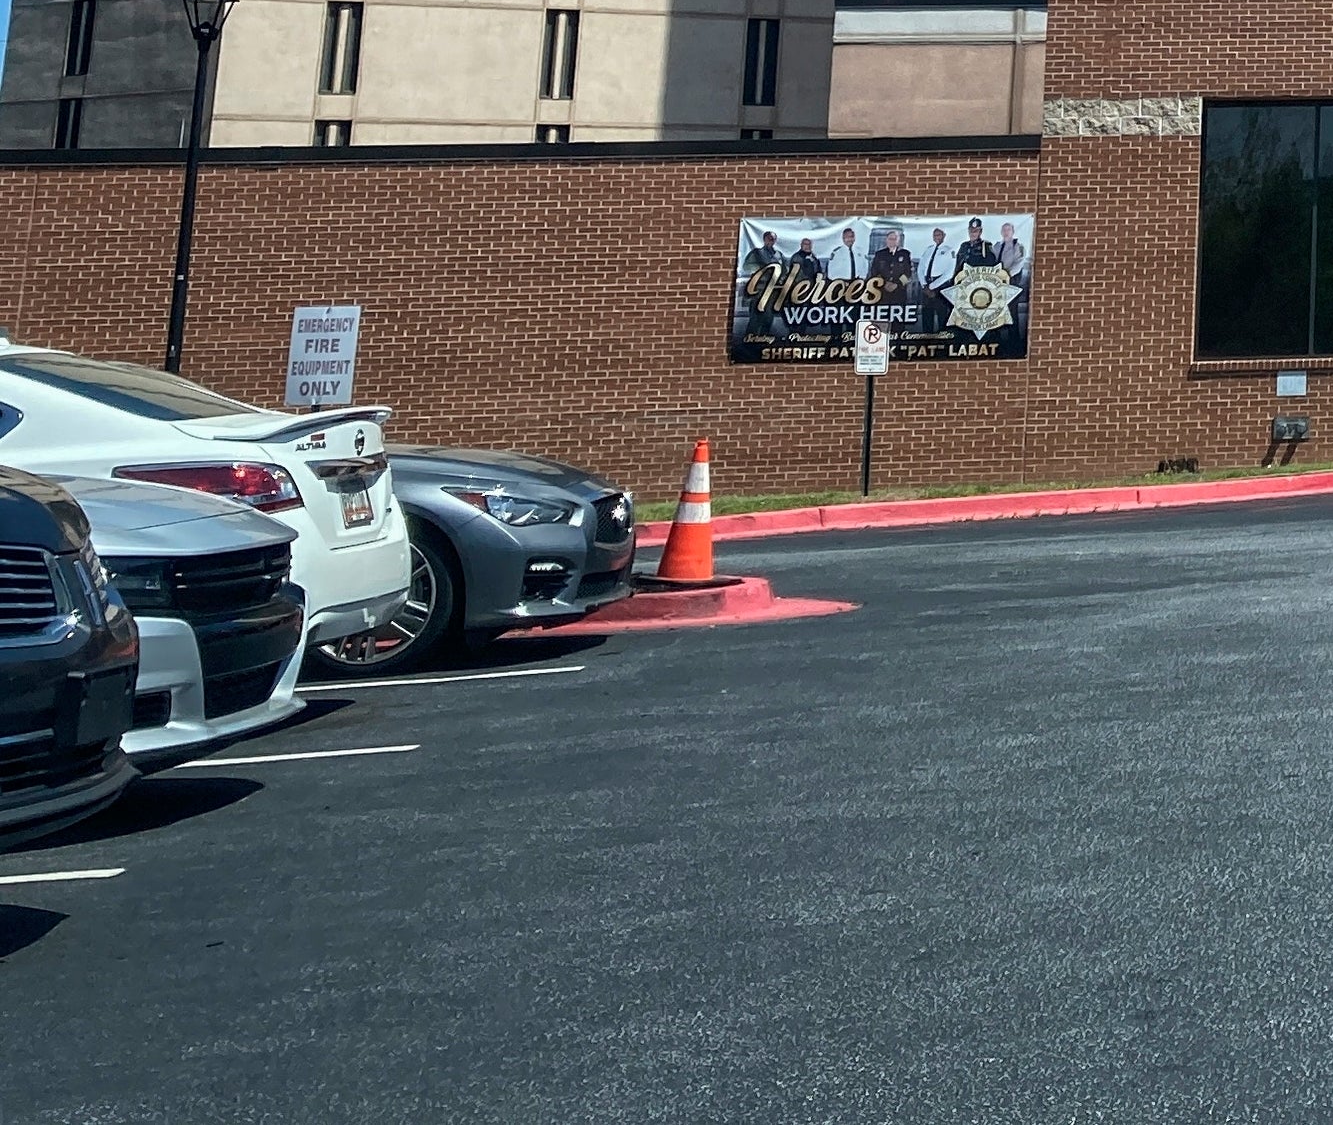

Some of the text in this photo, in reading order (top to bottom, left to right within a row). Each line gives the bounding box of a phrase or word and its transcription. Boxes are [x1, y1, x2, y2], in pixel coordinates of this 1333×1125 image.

[747, 263, 885, 312] Heroes
[783, 305, 918, 324] WORK HERE
[297, 317, 355, 333] EMERGENCY
[304, 339, 340, 353] FIRE
[761, 346, 826, 360] SHERIFF
[900, 344, 945, 357] "PAT"
[948, 343, 999, 356] LABAT
[291, 359, 351, 376] EQUIPMENT
[299, 380, 340, 396] ONLY
